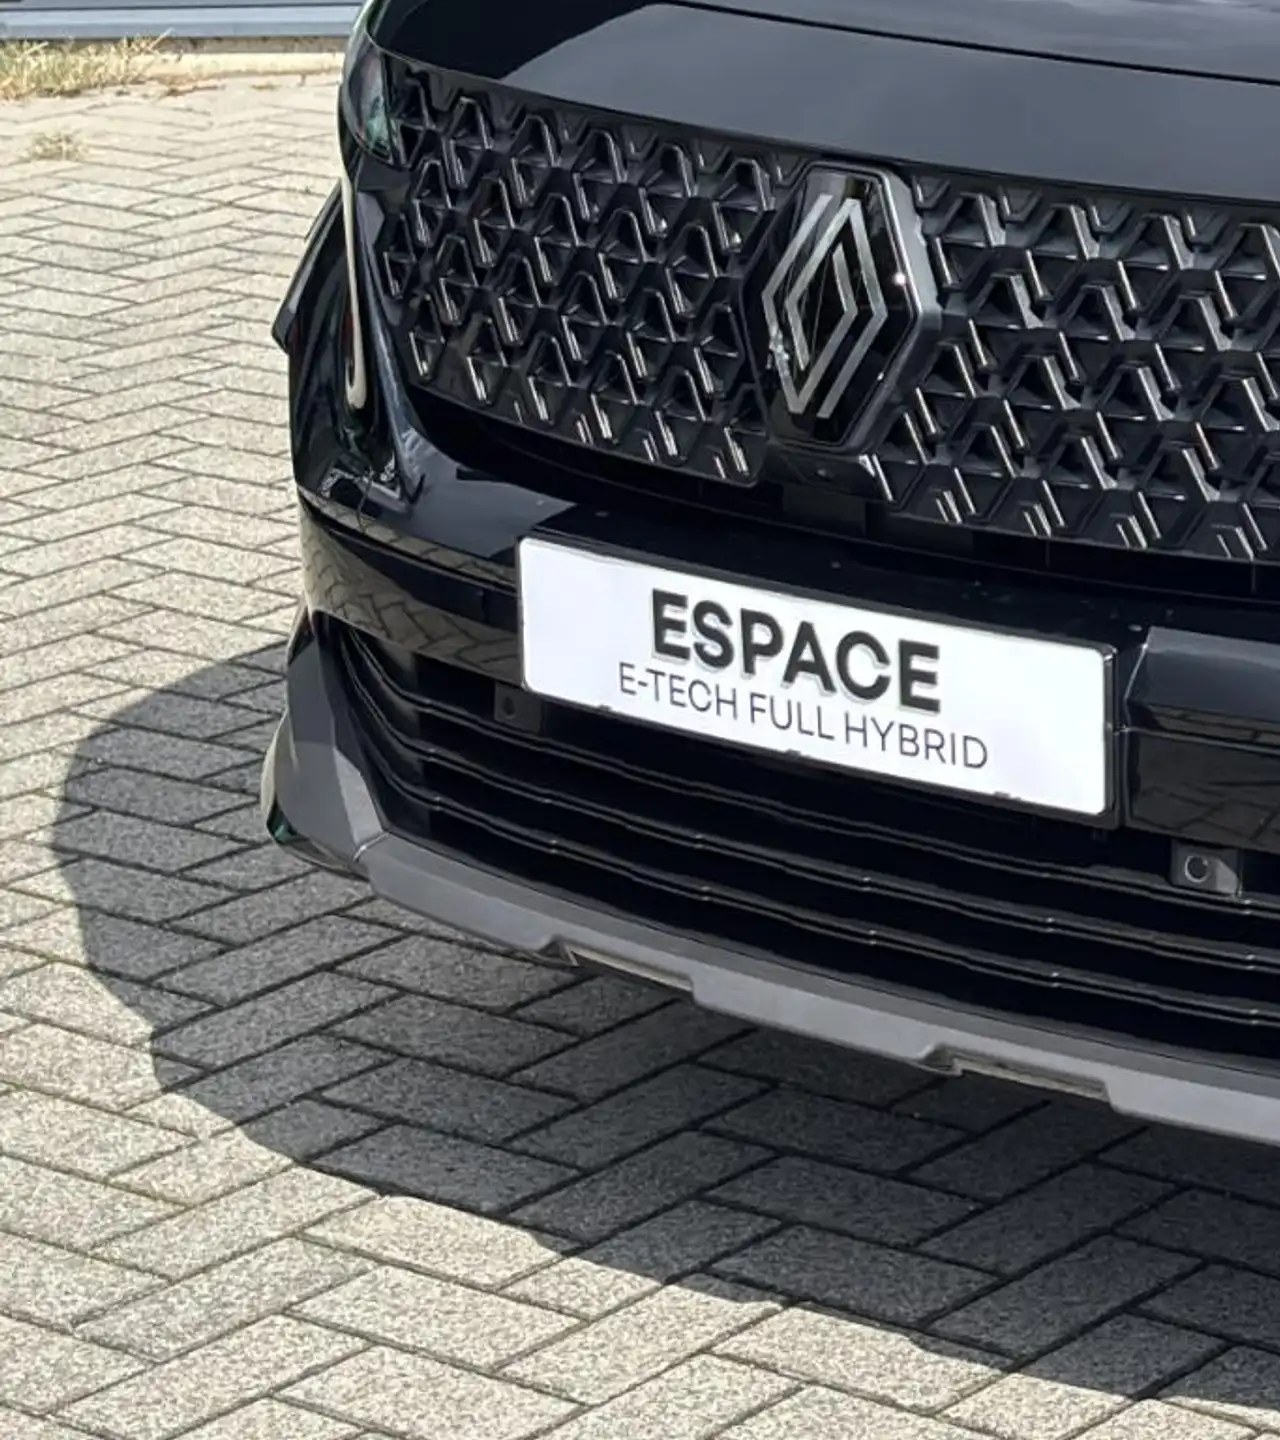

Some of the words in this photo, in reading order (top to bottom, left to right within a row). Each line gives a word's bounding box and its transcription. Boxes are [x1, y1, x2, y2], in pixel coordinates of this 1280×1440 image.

[650, 587, 942, 714] ESPACE
[617, 661, 739, 721] E-TECH
[748, 692, 836, 742] FULL
[843, 712, 989, 770] HYBRID
